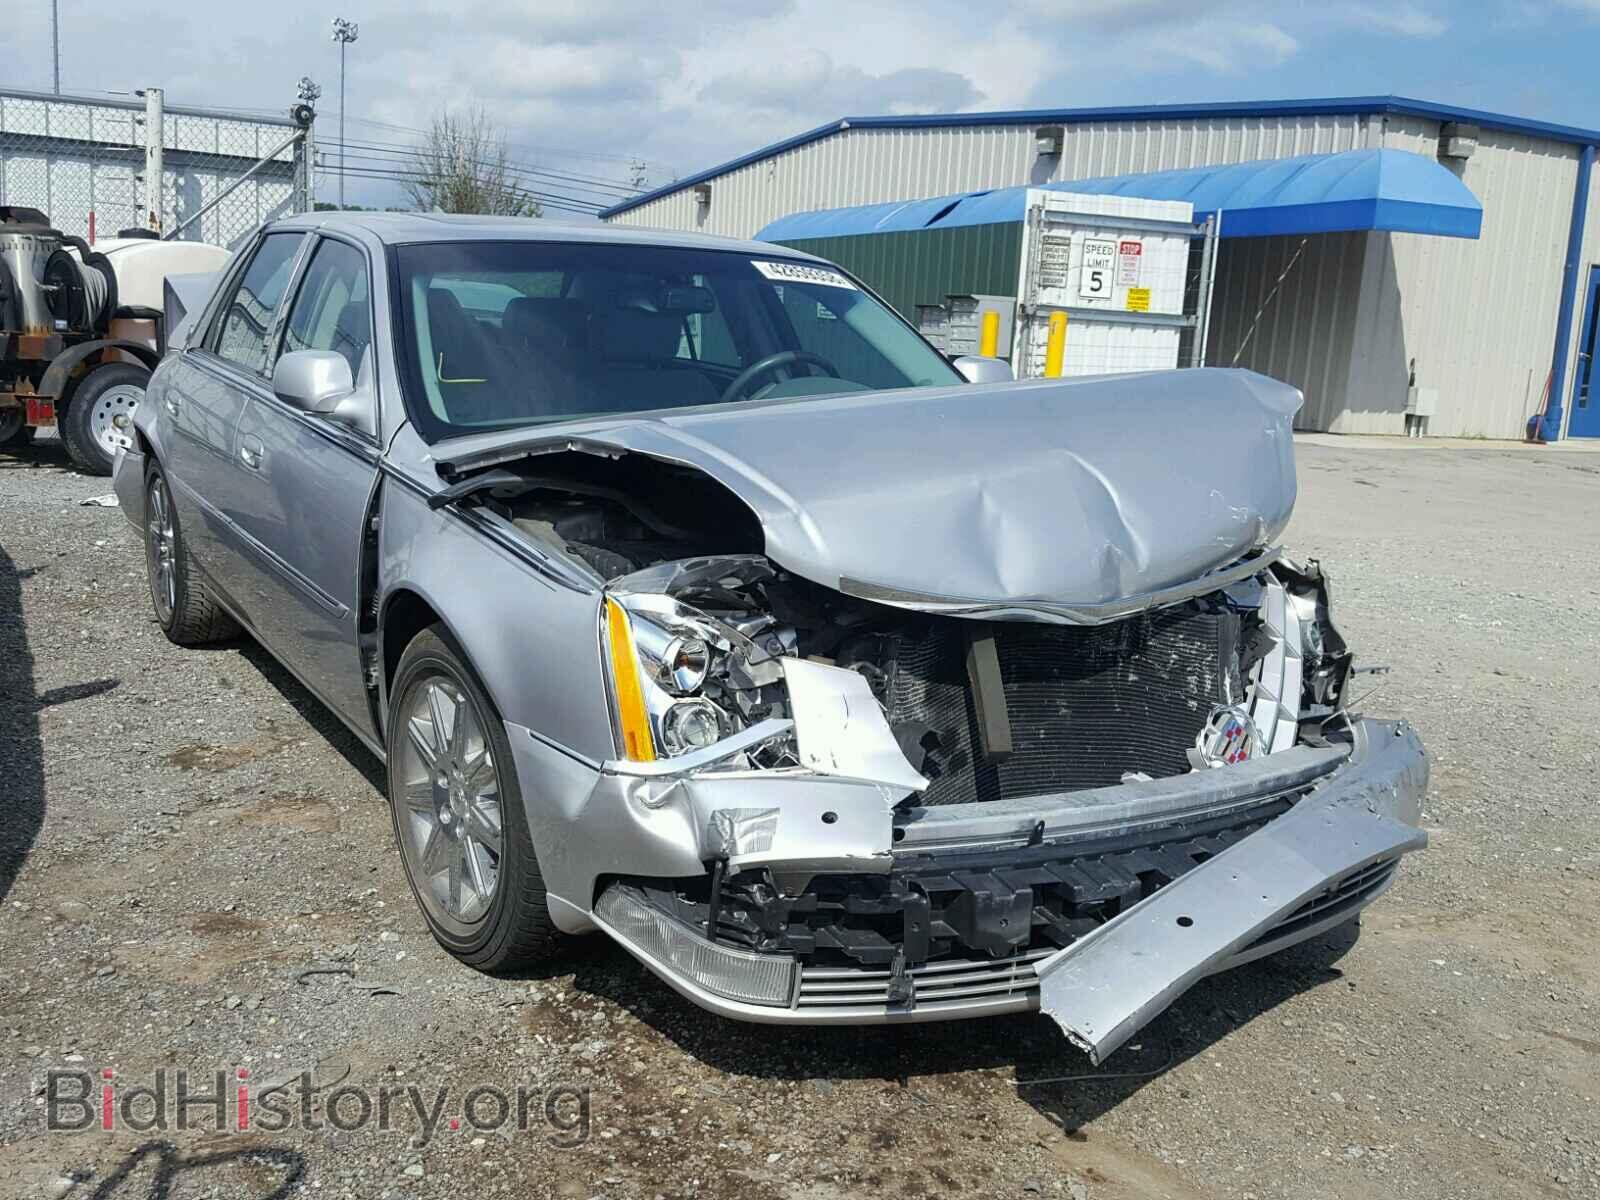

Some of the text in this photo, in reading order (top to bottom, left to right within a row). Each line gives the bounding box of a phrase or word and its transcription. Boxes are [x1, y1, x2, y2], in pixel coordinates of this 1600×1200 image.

[1085, 244, 1114, 256] SPEED
[1122, 243, 1140, 255] STOP
[1087, 259, 1110, 268] LIMIT
[1090, 271, 1103, 292] 5
